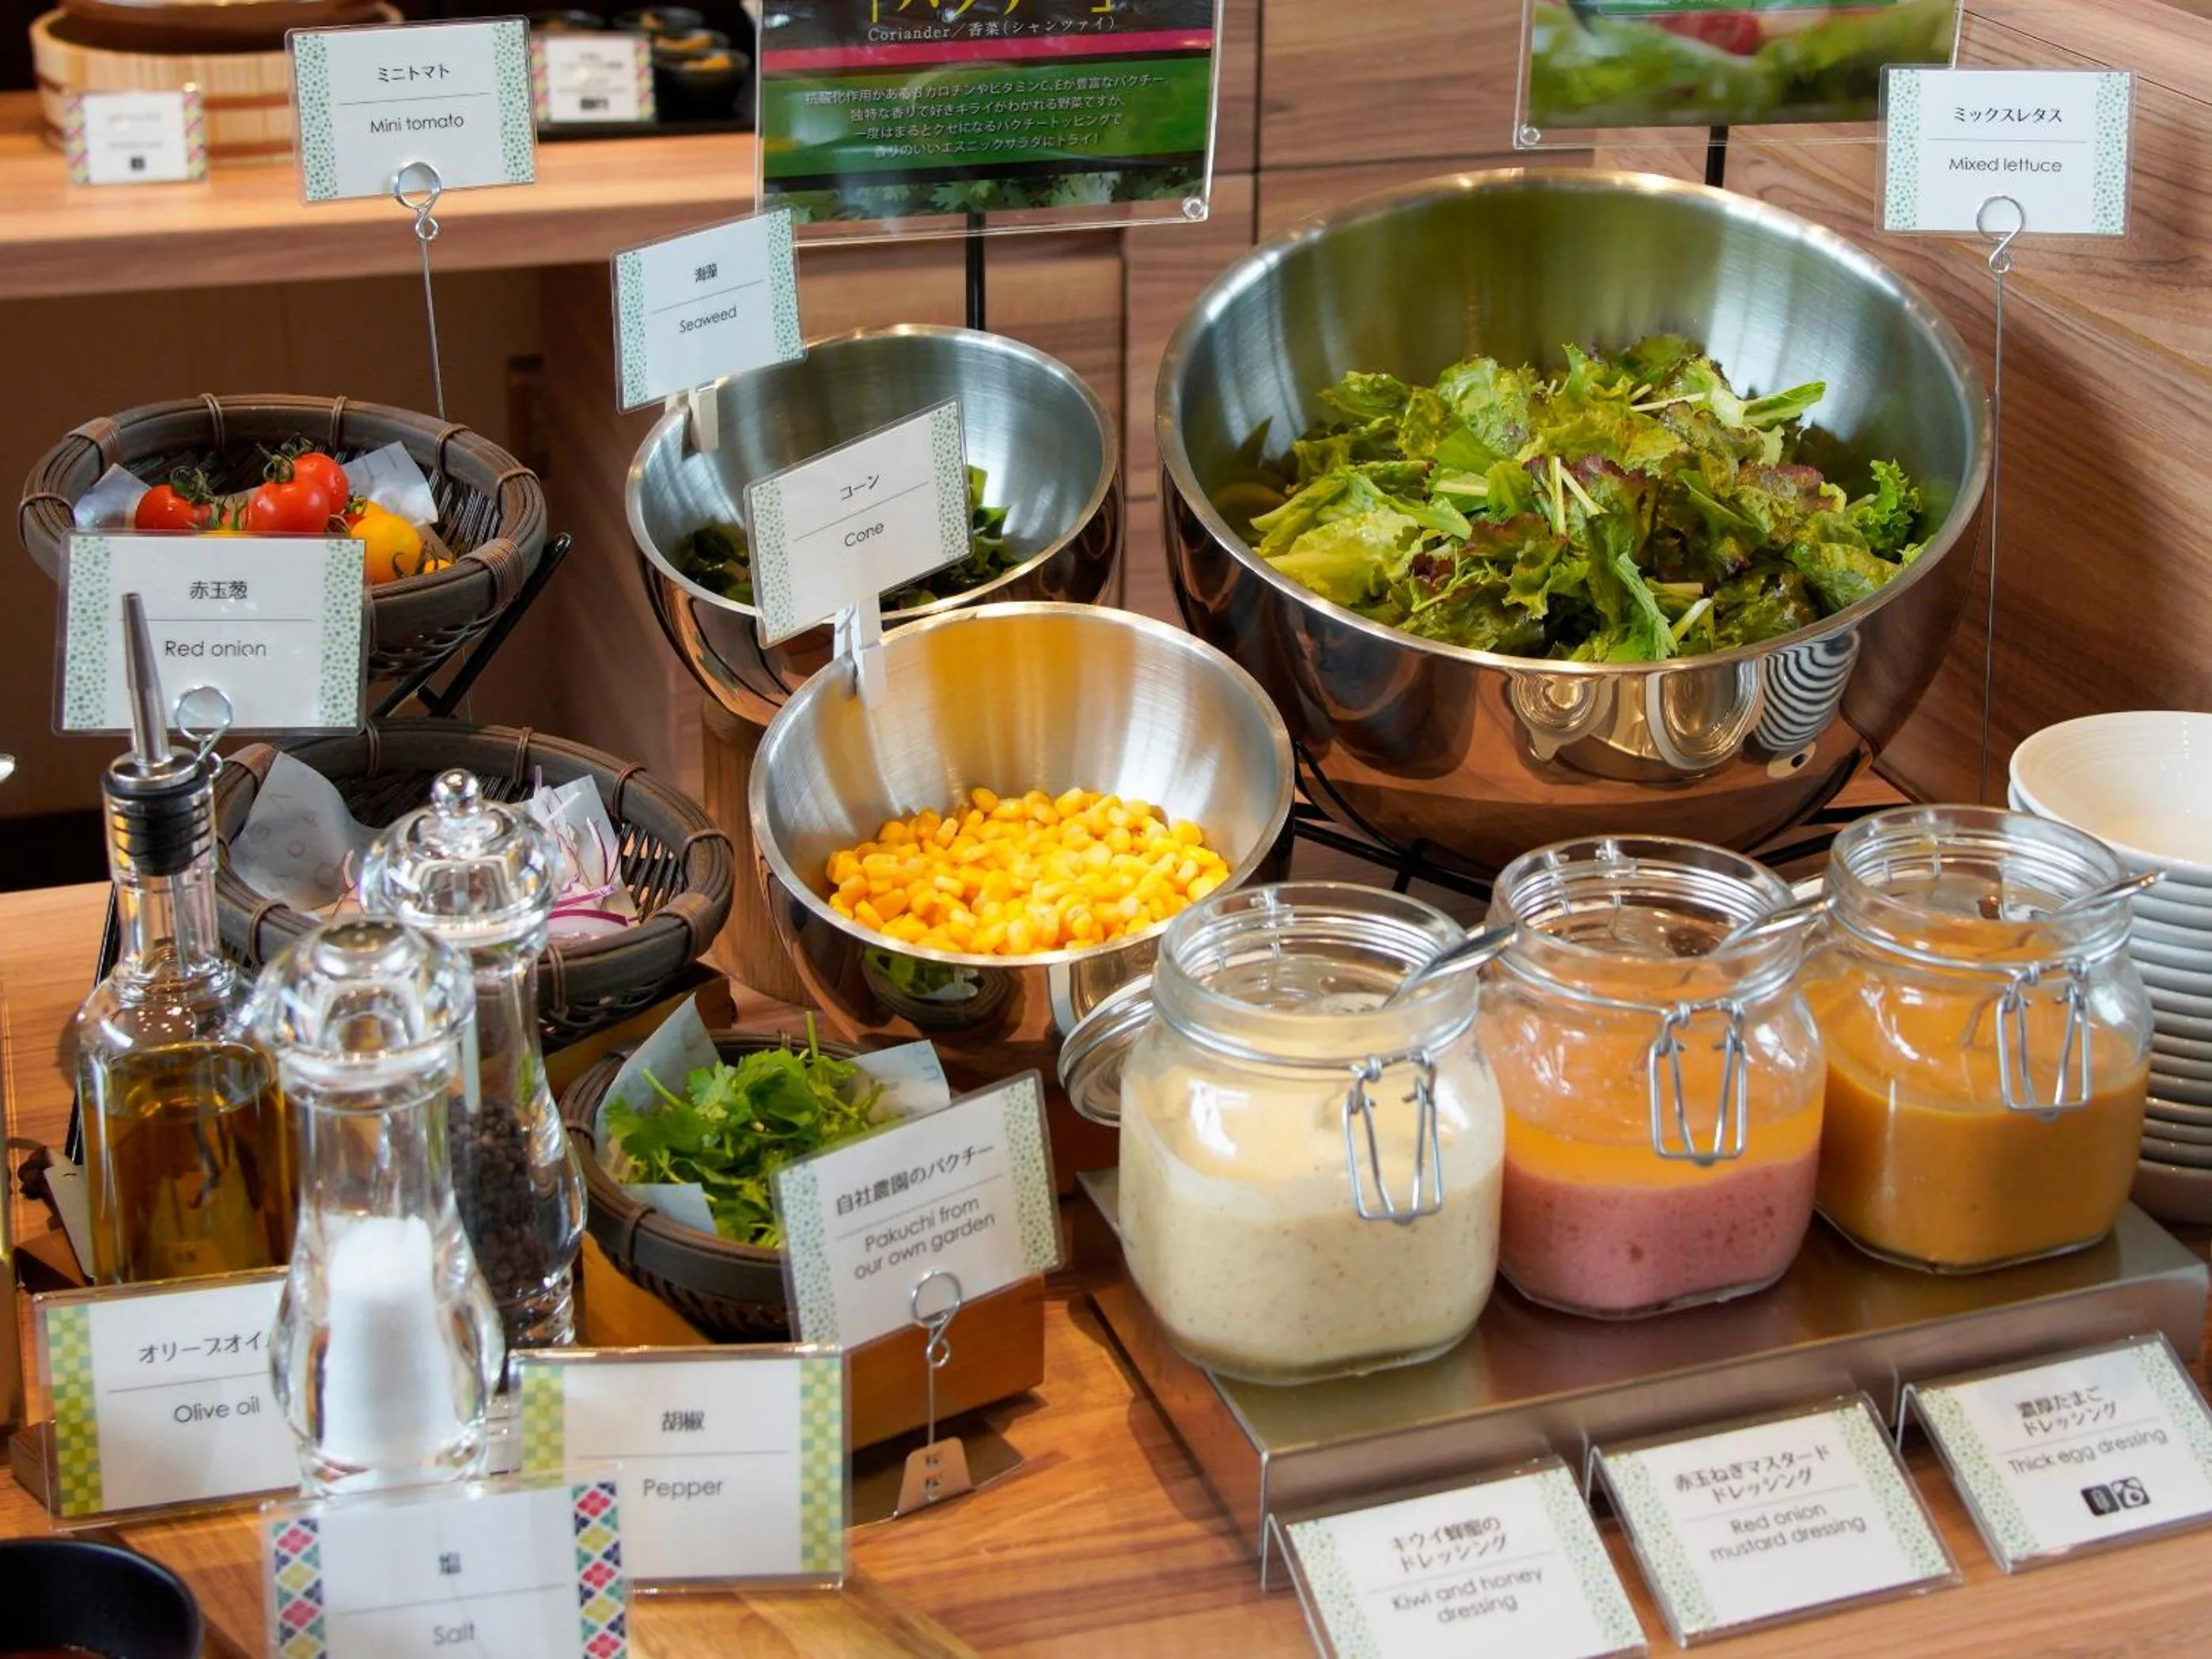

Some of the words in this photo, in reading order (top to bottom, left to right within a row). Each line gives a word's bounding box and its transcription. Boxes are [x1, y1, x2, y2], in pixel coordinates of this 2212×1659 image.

[377, 63, 450, 82] ミニトマト
[370, 117, 403, 134] Mini
[405, 113, 464, 131] tomato
[1954, 107, 2062, 123] ミックスレタス
[1949, 157, 1999, 172] Mixed
[2003, 157, 2062, 172] lettuce
[679, 303, 737, 334] Seaweed
[839, 474, 880, 502] コーン
[844, 522, 884, 547] Cone
[189, 580, 248, 600] 赤玉葱
[165, 639, 205, 657] Red
[210, 639, 267, 657] onion
[836, 1145, 994, 1217] 自社農園のパクチー
[865, 1210, 936, 1252] Pakuchi
[939, 1197, 979, 1224] from
[854, 1256, 884, 1280] our
[888, 1240, 927, 1266] own
[930, 1214, 995, 1253] garden
[174, 1402, 230, 1423] Olive
[237, 1395, 260, 1415] oil
[661, 1409, 706, 1433] 胡椒
[2023, 1400, 2117, 1437] ドレッシング
[2007, 1453, 2055, 1474] Thick
[2057, 1445, 2096, 1464] egg
[2096, 1429, 2169, 1453] dressing
[1674, 1444, 1830, 1492] 赤玉ねぎマスタード
[642, 1477, 725, 1501] Pepper
[1710, 1466, 1812, 1504] ドレッシング
[1729, 1513, 1771, 1535] Red
[1773, 1503, 1828, 1526] onion
[1400, 1533, 1507, 1574] ドレッシング
[1710, 1532, 1787, 1562] mustard
[1790, 1516, 1867, 1543] dressing
[1392, 1588, 1433, 1610] Kiwi
[1435, 1578, 1478, 1602] and
[1479, 1567, 1543, 1591] honey
[1437, 1594, 1519, 1624] dressing
[433, 1620, 475, 1647] Salt
